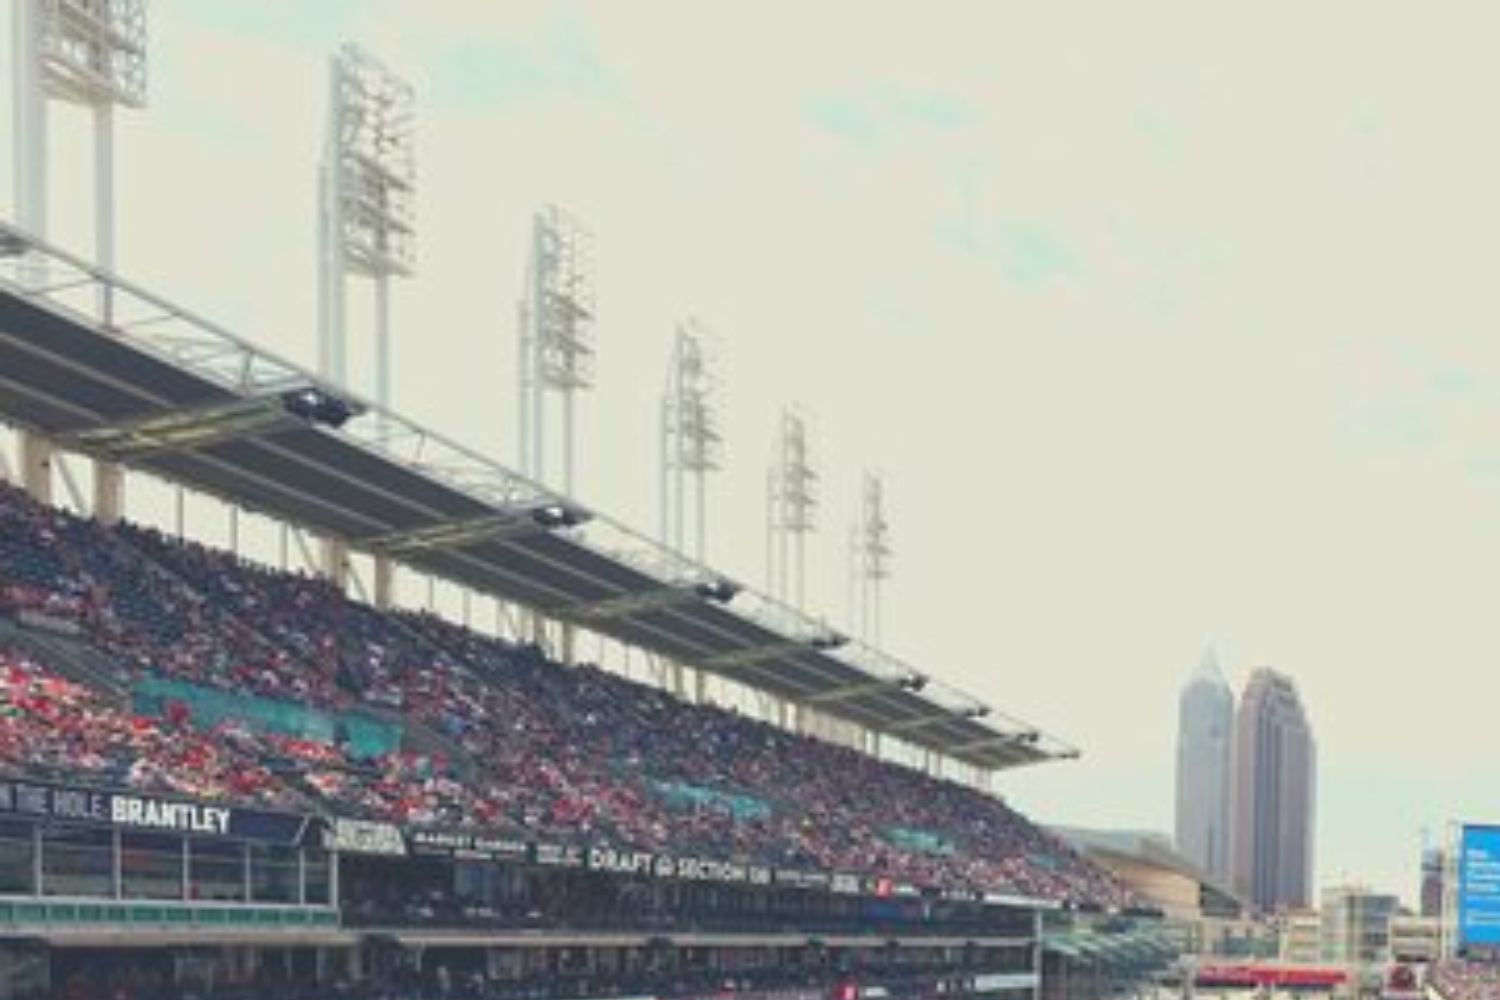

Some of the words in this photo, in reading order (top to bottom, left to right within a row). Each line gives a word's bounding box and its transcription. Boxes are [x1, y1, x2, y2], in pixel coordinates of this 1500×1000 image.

[110, 796, 230, 835] BRANTLEY
[589, 847, 654, 875] DRAFT
[677, 856, 747, 881] SECTION
